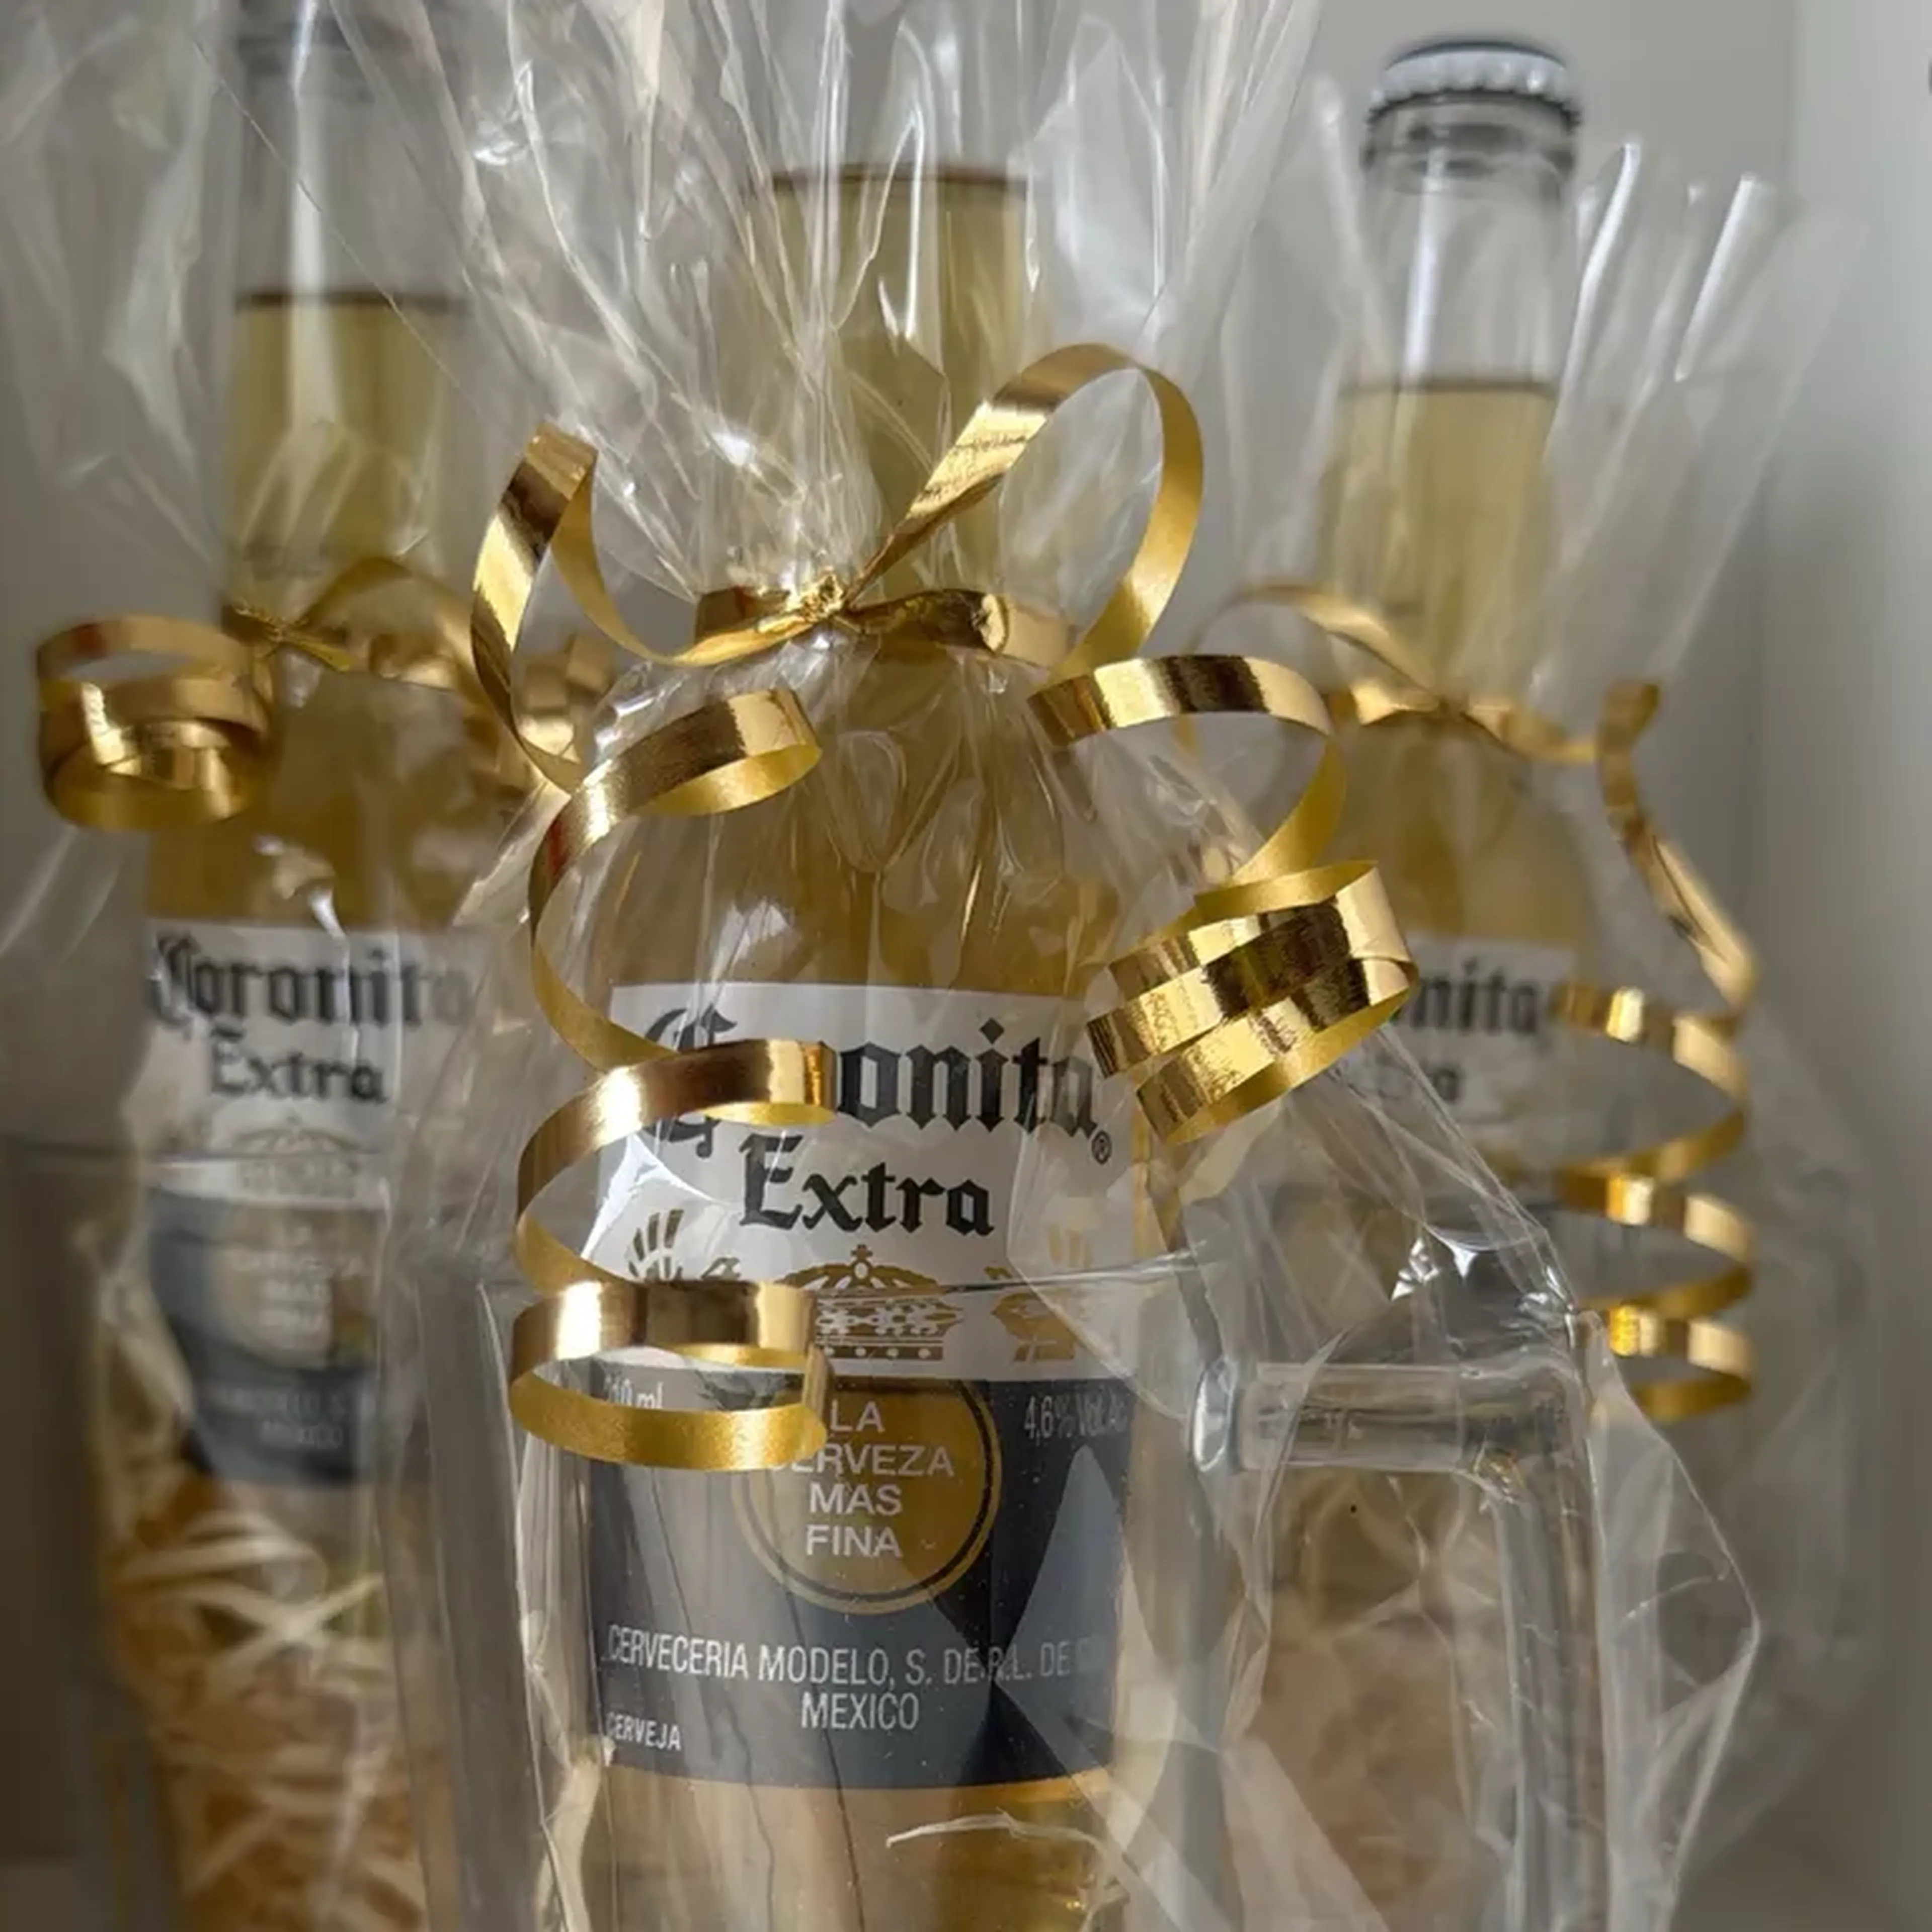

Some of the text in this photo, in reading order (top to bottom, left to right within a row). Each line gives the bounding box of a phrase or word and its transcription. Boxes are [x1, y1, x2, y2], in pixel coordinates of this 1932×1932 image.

[1411, 957, 1544, 1036] nita
[209, 1023, 387, 1103] Extra
[739, 1133, 995, 1236] Extra
[830, 1399, 886, 1433] LA
[767, 1442, 955, 1478] RVEZA
[809, 1481, 903, 1515] MAS
[806, 1524, 904, 1558] FINA
[607, 1624, 749, 1680] CERVECERIA
[758, 1644, 895, 1689] MODELO,
[905, 1647, 932, 1685] S.
[1039, 1639, 1071, 1678] DE
[800, 1691, 920, 1730] MEXICO
[606, 1712, 682, 1751] CERVEJA
